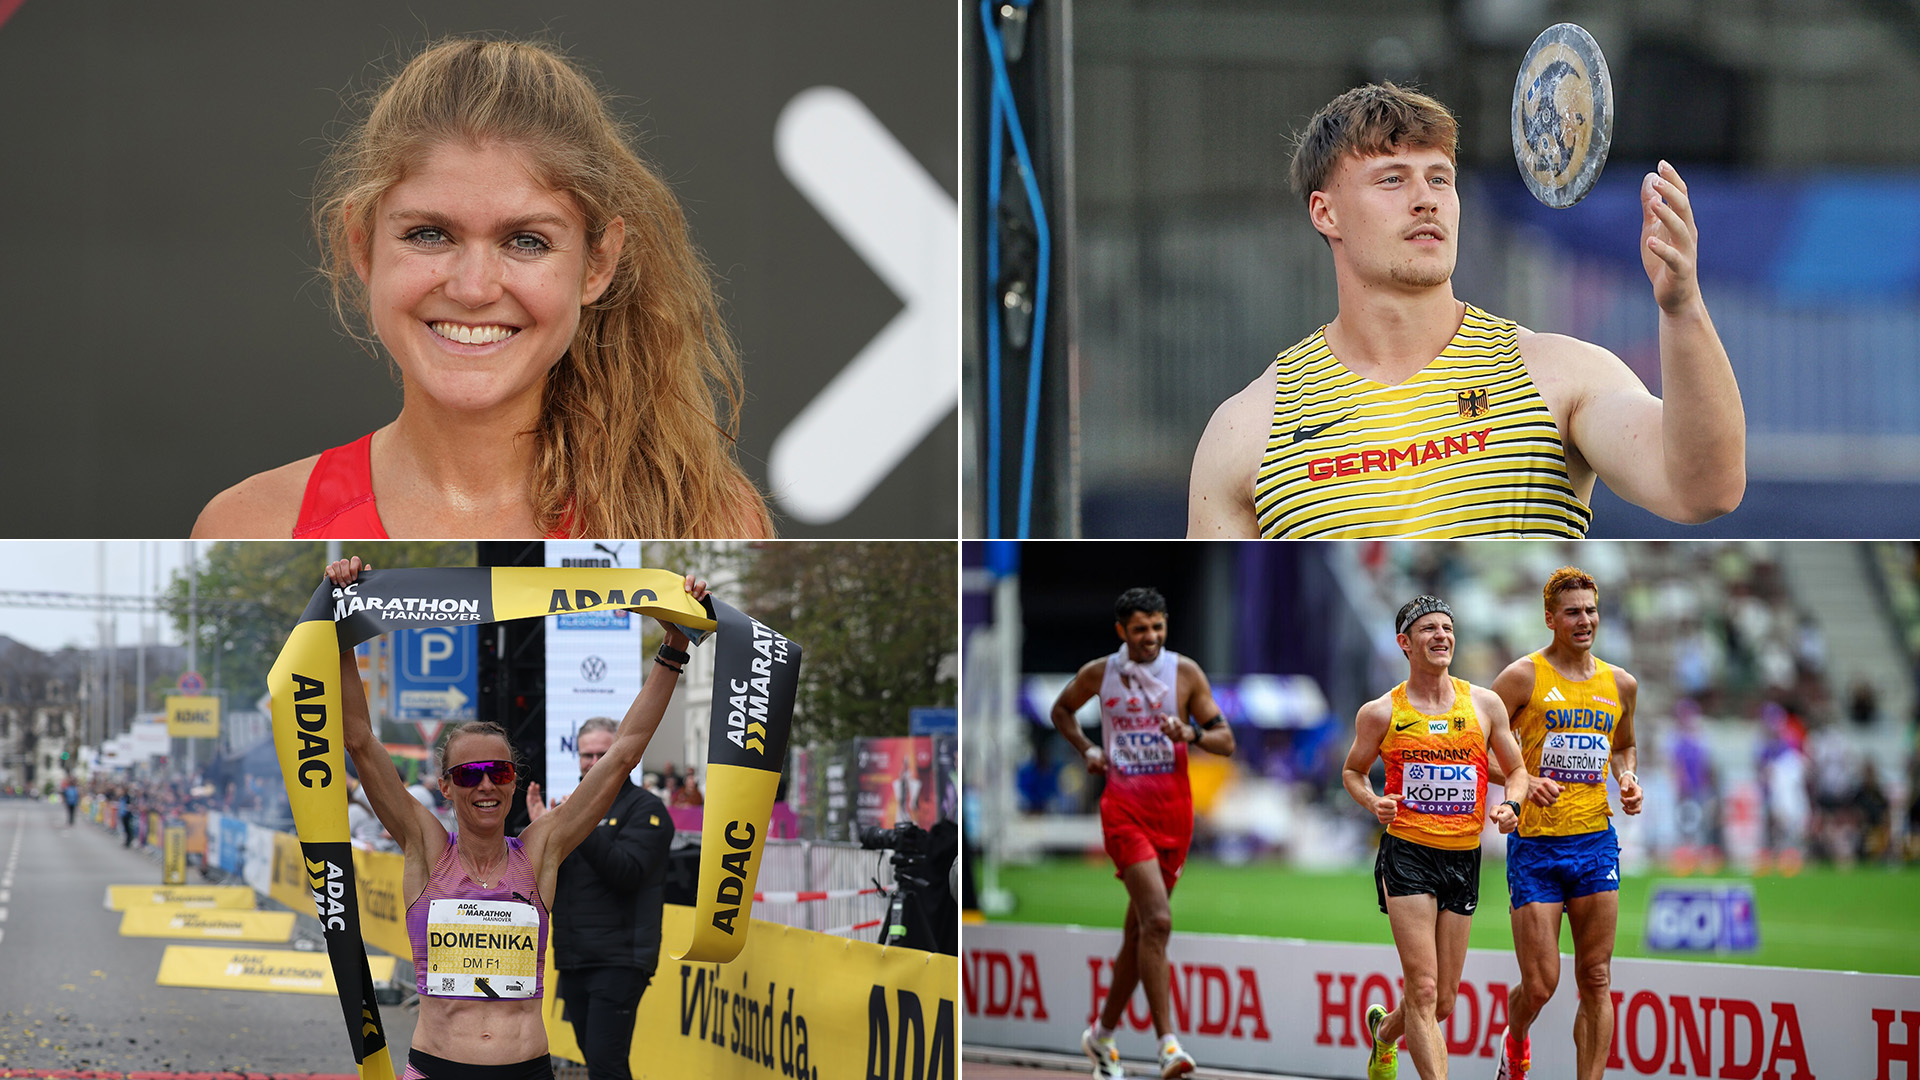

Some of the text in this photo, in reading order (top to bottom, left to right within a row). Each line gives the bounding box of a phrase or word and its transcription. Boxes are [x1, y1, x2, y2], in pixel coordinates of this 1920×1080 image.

[1308, 427, 1493, 482] GERMANY
[333, 597, 479, 622] MARATHON
[381, 610, 481, 621] HANNOVER
[421, 633, 454, 675] P
[726, 678, 749, 749] ADAC
[1545, 708, 1614, 734] SWEDEN
[291, 673, 332, 788] ADAC
[1429, 723, 1448, 731] WGV
[1127, 733, 1169, 747] TDK
[1565, 735, 1606, 750] TDK
[1402, 748, 1472, 762] GERMANY
[1543, 753, 1607, 769] KARLSTRÖM 37
[1424, 765, 1472, 781] TDK
[1407, 784, 1475, 801] KÖPP 338
[712, 820, 756, 936] ADAC
[326, 860, 346, 931] ADAC
[465, 909, 512, 918] MARATHON
[430, 932, 534, 951] DOMENIKA
[432, 963, 438, 972] 0
[463, 957, 500, 969] DM F1
[680, 963, 729, 1048] Wir
[730, 970, 776, 1071] sind
[780, 987, 818, 1080] da.
[1315, 971, 1510, 1058] HODA
[866, 983, 955, 1080] ADA
